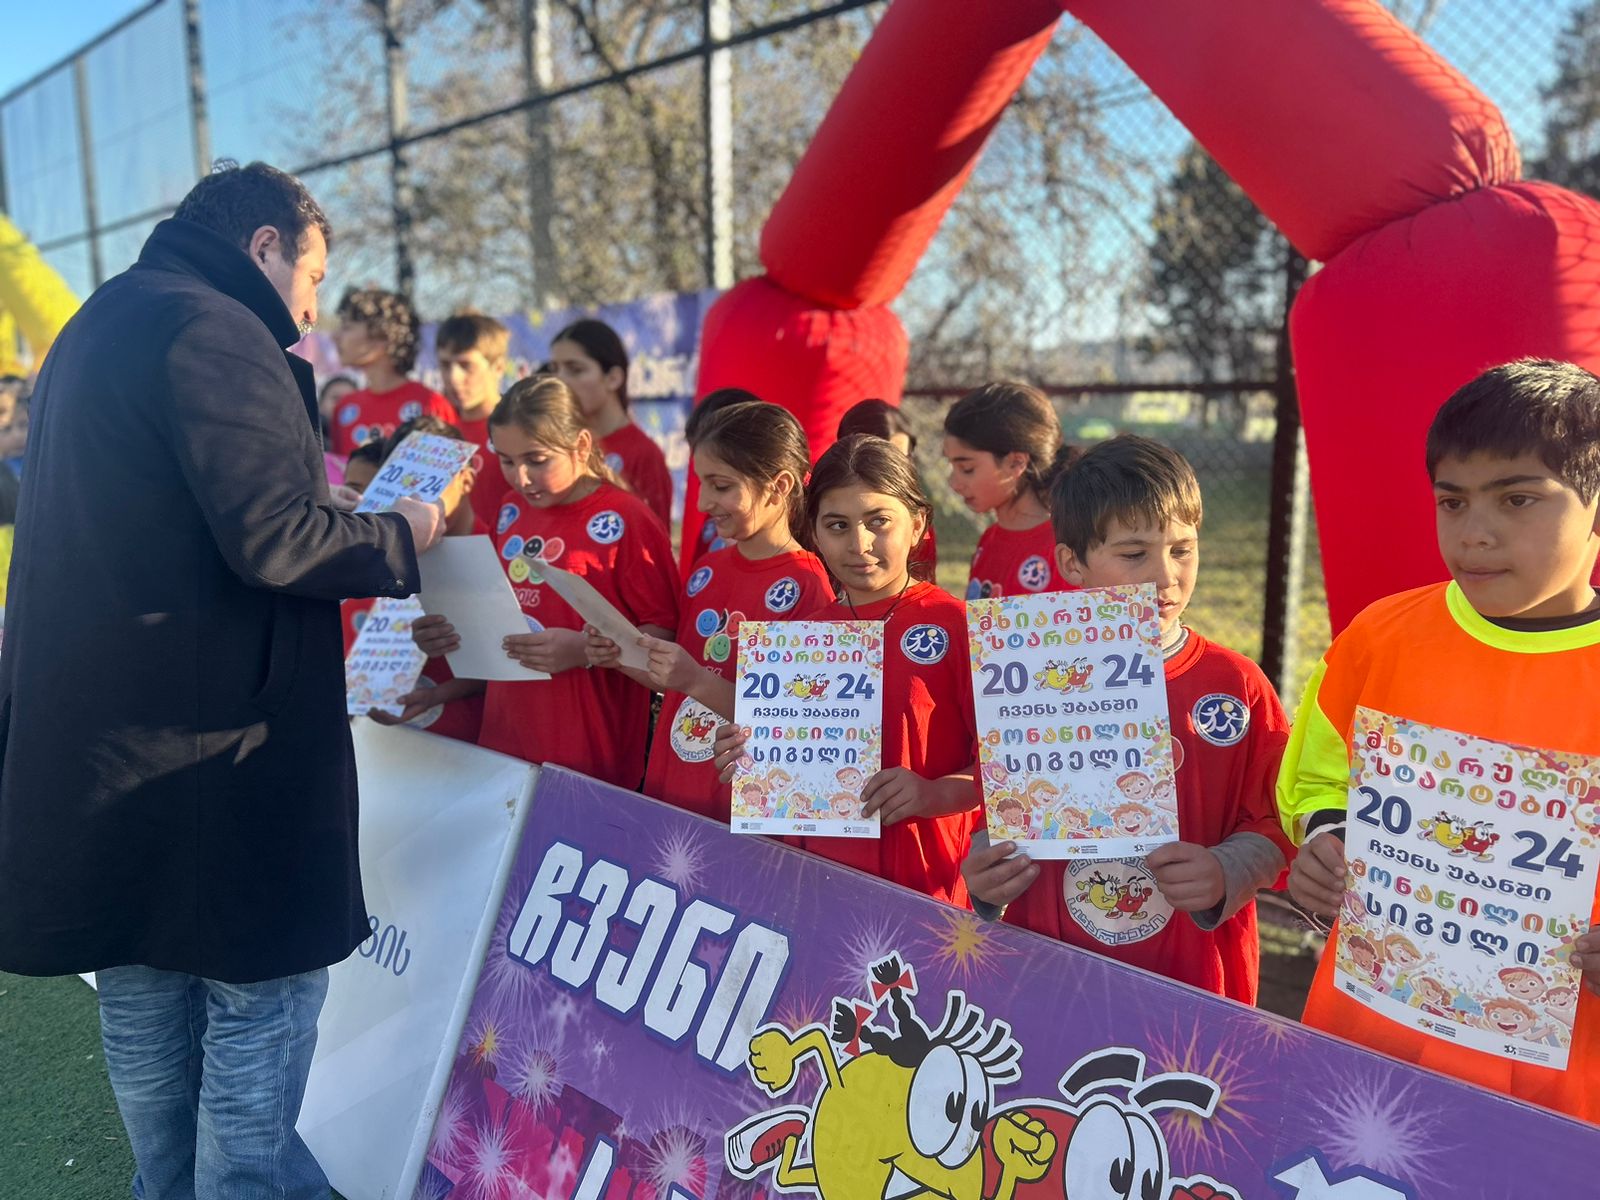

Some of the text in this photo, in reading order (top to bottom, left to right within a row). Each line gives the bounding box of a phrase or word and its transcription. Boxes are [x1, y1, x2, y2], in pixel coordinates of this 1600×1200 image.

[379, 464, 404, 484] 20
[419, 476, 445, 496] 24
[514, 587, 540, 606] 016
[366, 617, 389, 633] 20
[979, 601, 1144, 631] მხიარული
[747, 633, 875, 648] მხიარული
[991, 623, 1133, 651] სტარტები
[754, 650, 863, 664] სტარტები
[742, 672, 875, 700] 20 24
[981, 652, 1155, 696] 20 24
[753, 707, 860, 719] ჩვენს უბანში
[998, 697, 1139, 718] ჩვენს უბანში
[753, 746, 857, 765] სიგელი
[1006, 748, 1142, 773] სიგელი
[1366, 730, 1590, 799] მხიარული
[1376, 757, 1567, 820] სტარტები
[1355, 785, 1584, 879] 20 24
[1368, 839, 1552, 903] ჩვენს უბანში
[1366, 891, 1540, 966] სიგელი
[509, 841, 790, 1072] ჩვენი
